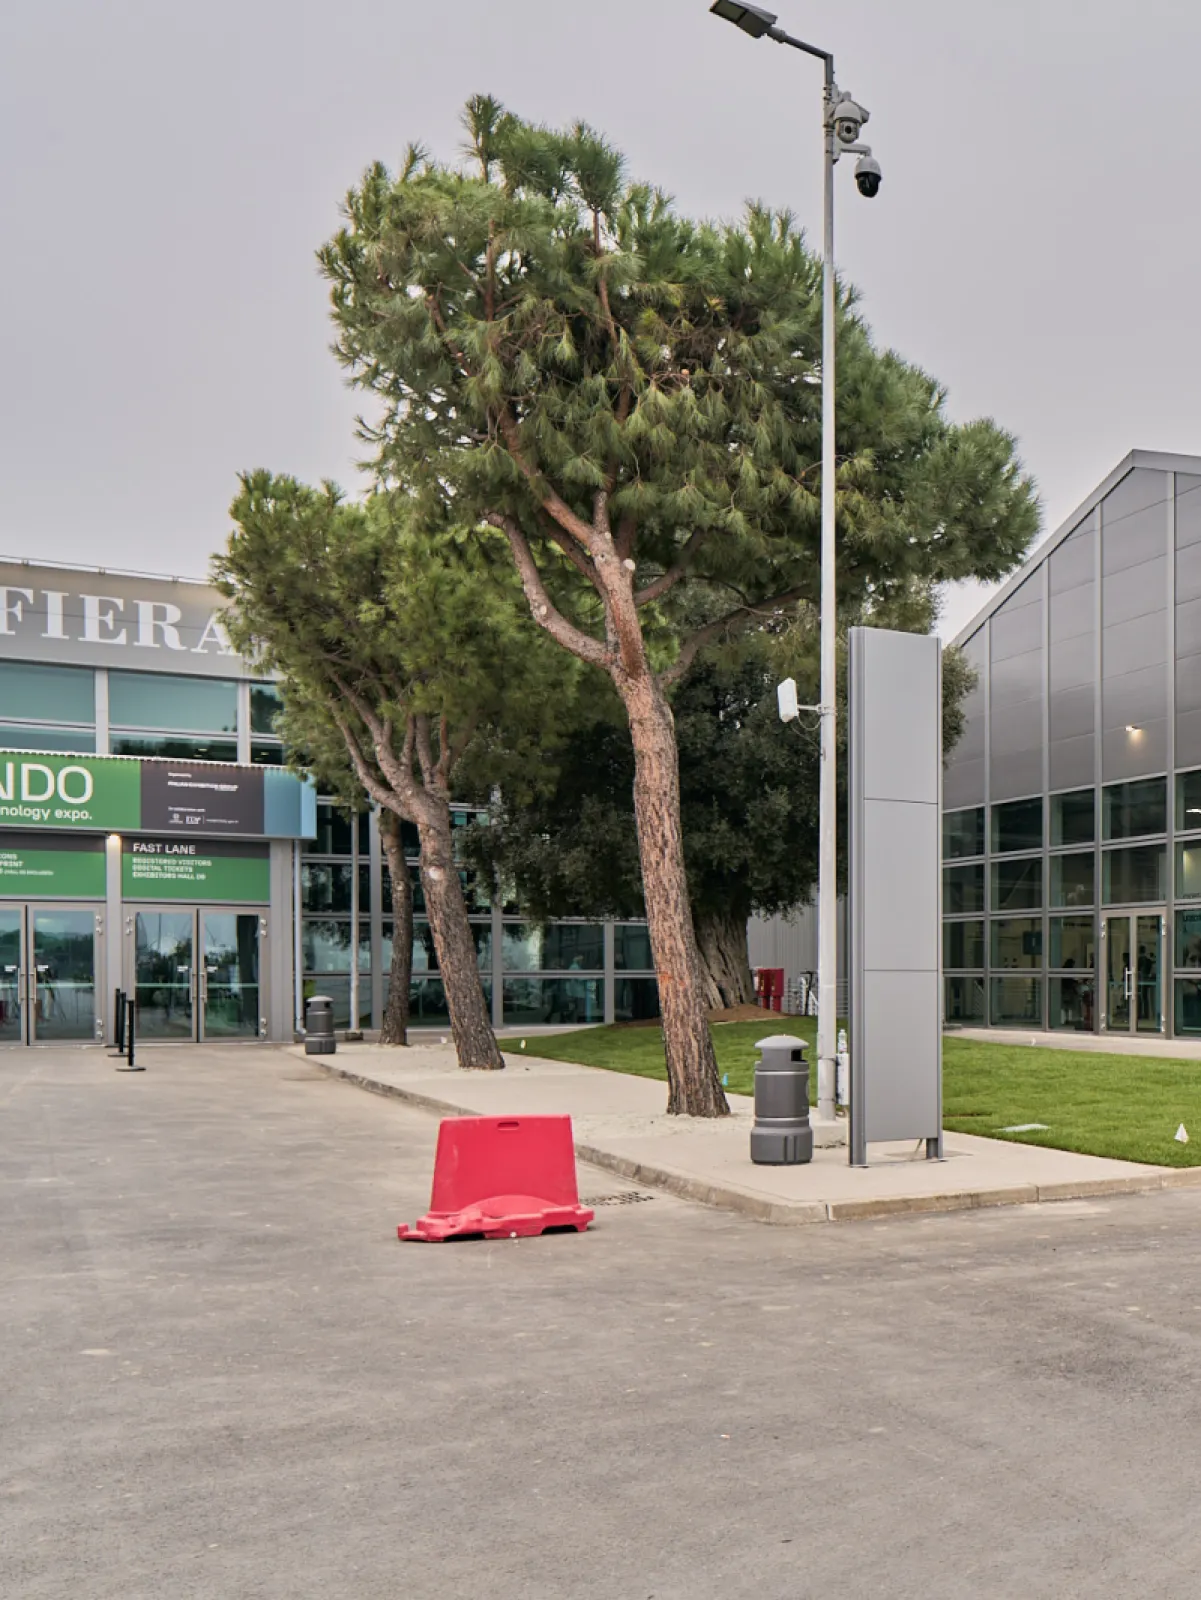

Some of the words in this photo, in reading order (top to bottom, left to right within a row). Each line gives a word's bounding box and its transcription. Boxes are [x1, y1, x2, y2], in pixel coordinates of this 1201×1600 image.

[0, 586, 242, 657] FIERA
[54, 808, 93, 822] expo.
[132, 842, 162, 854] FAST
[164, 844, 197, 855] LANE
